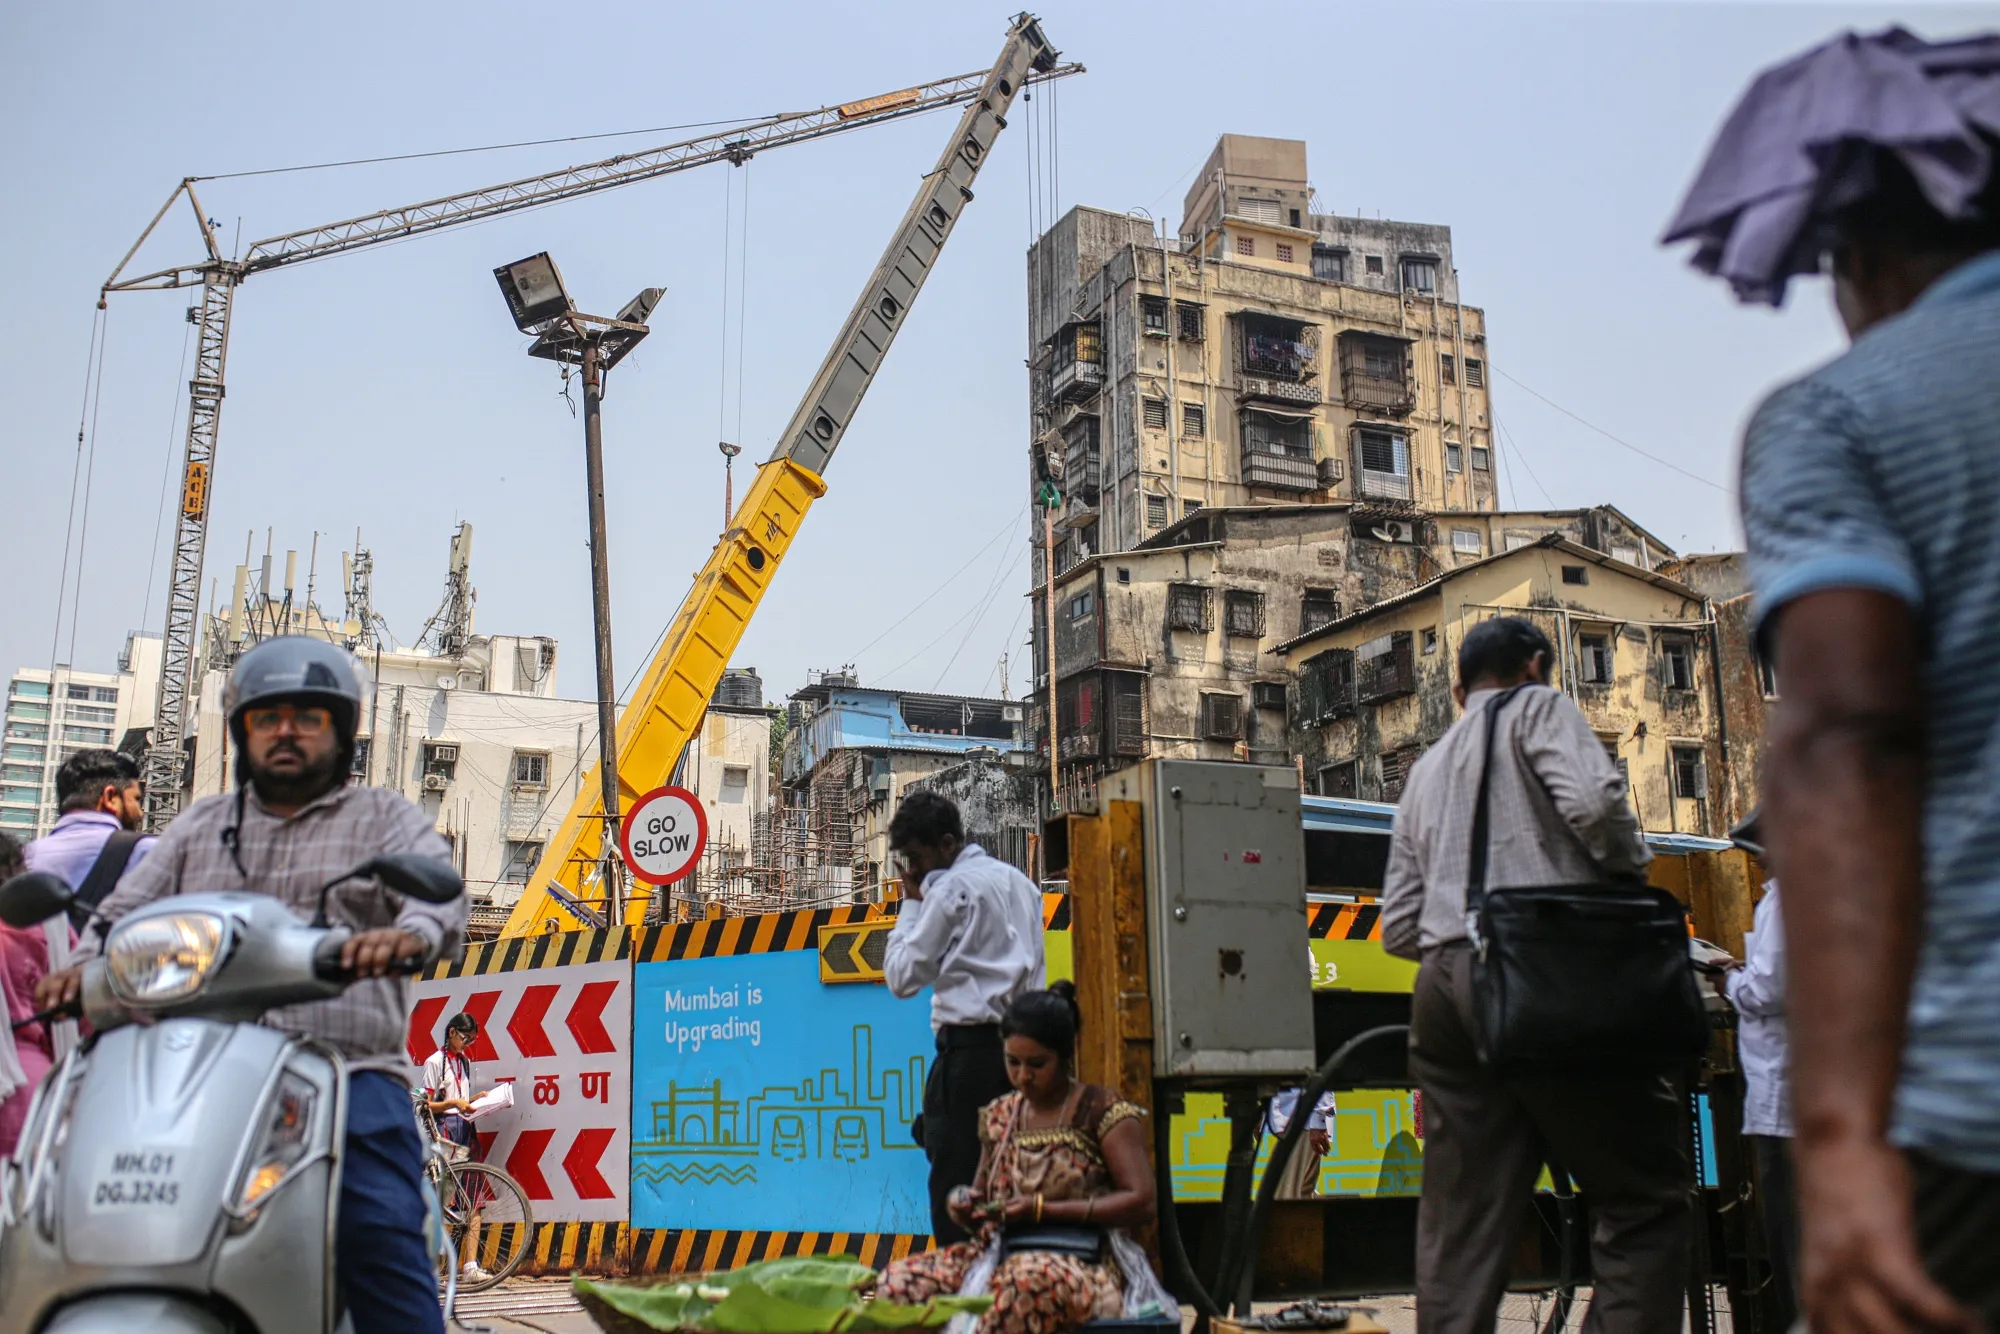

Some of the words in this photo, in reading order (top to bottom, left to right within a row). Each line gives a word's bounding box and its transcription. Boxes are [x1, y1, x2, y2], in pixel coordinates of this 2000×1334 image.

[647, 816, 676, 835] GO
[633, 834, 690, 857] SLOW
[665, 983, 739, 1012] Mumbai
[747, 982, 763, 1006] is
[665, 1016, 761, 1053] Upgrading
